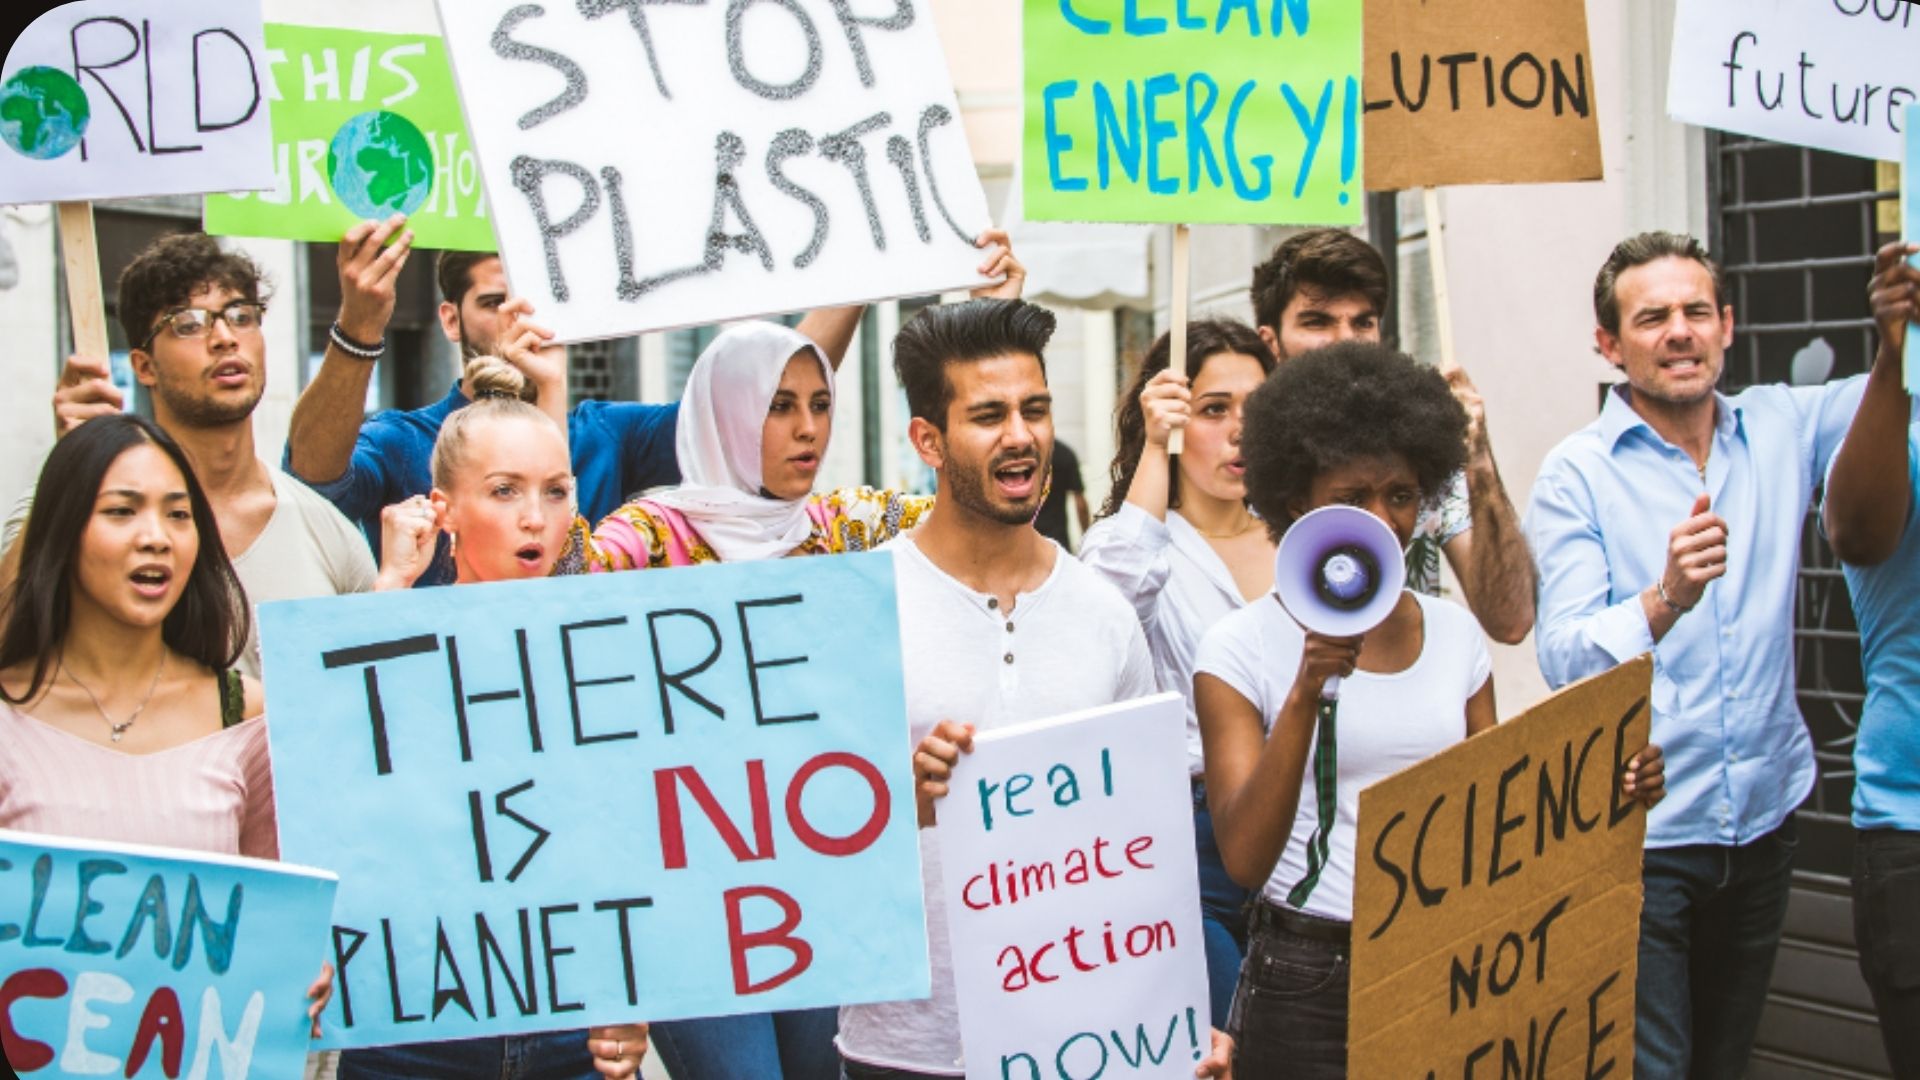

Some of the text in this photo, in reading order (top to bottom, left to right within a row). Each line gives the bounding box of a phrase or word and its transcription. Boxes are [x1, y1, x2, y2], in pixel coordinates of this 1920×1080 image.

[490, 0, 915, 130] STOP
[1722, 31, 1917, 133] future
[424, 131, 488, 218] HO
[509, 104, 980, 302] PLASTIC
[1043, 72, 1358, 206] ENERGY!
[321, 594, 820, 776] THERE
[468, 751, 892, 883] IS NO
[978, 747, 1113, 832] real
[1368, 695, 1648, 941] SCIENCE
[962, 835, 1155, 911] climate
[331, 885, 814, 1028] PLANET B
[996, 920, 1177, 992] action
[1450, 896, 1571, 1016] NOT
